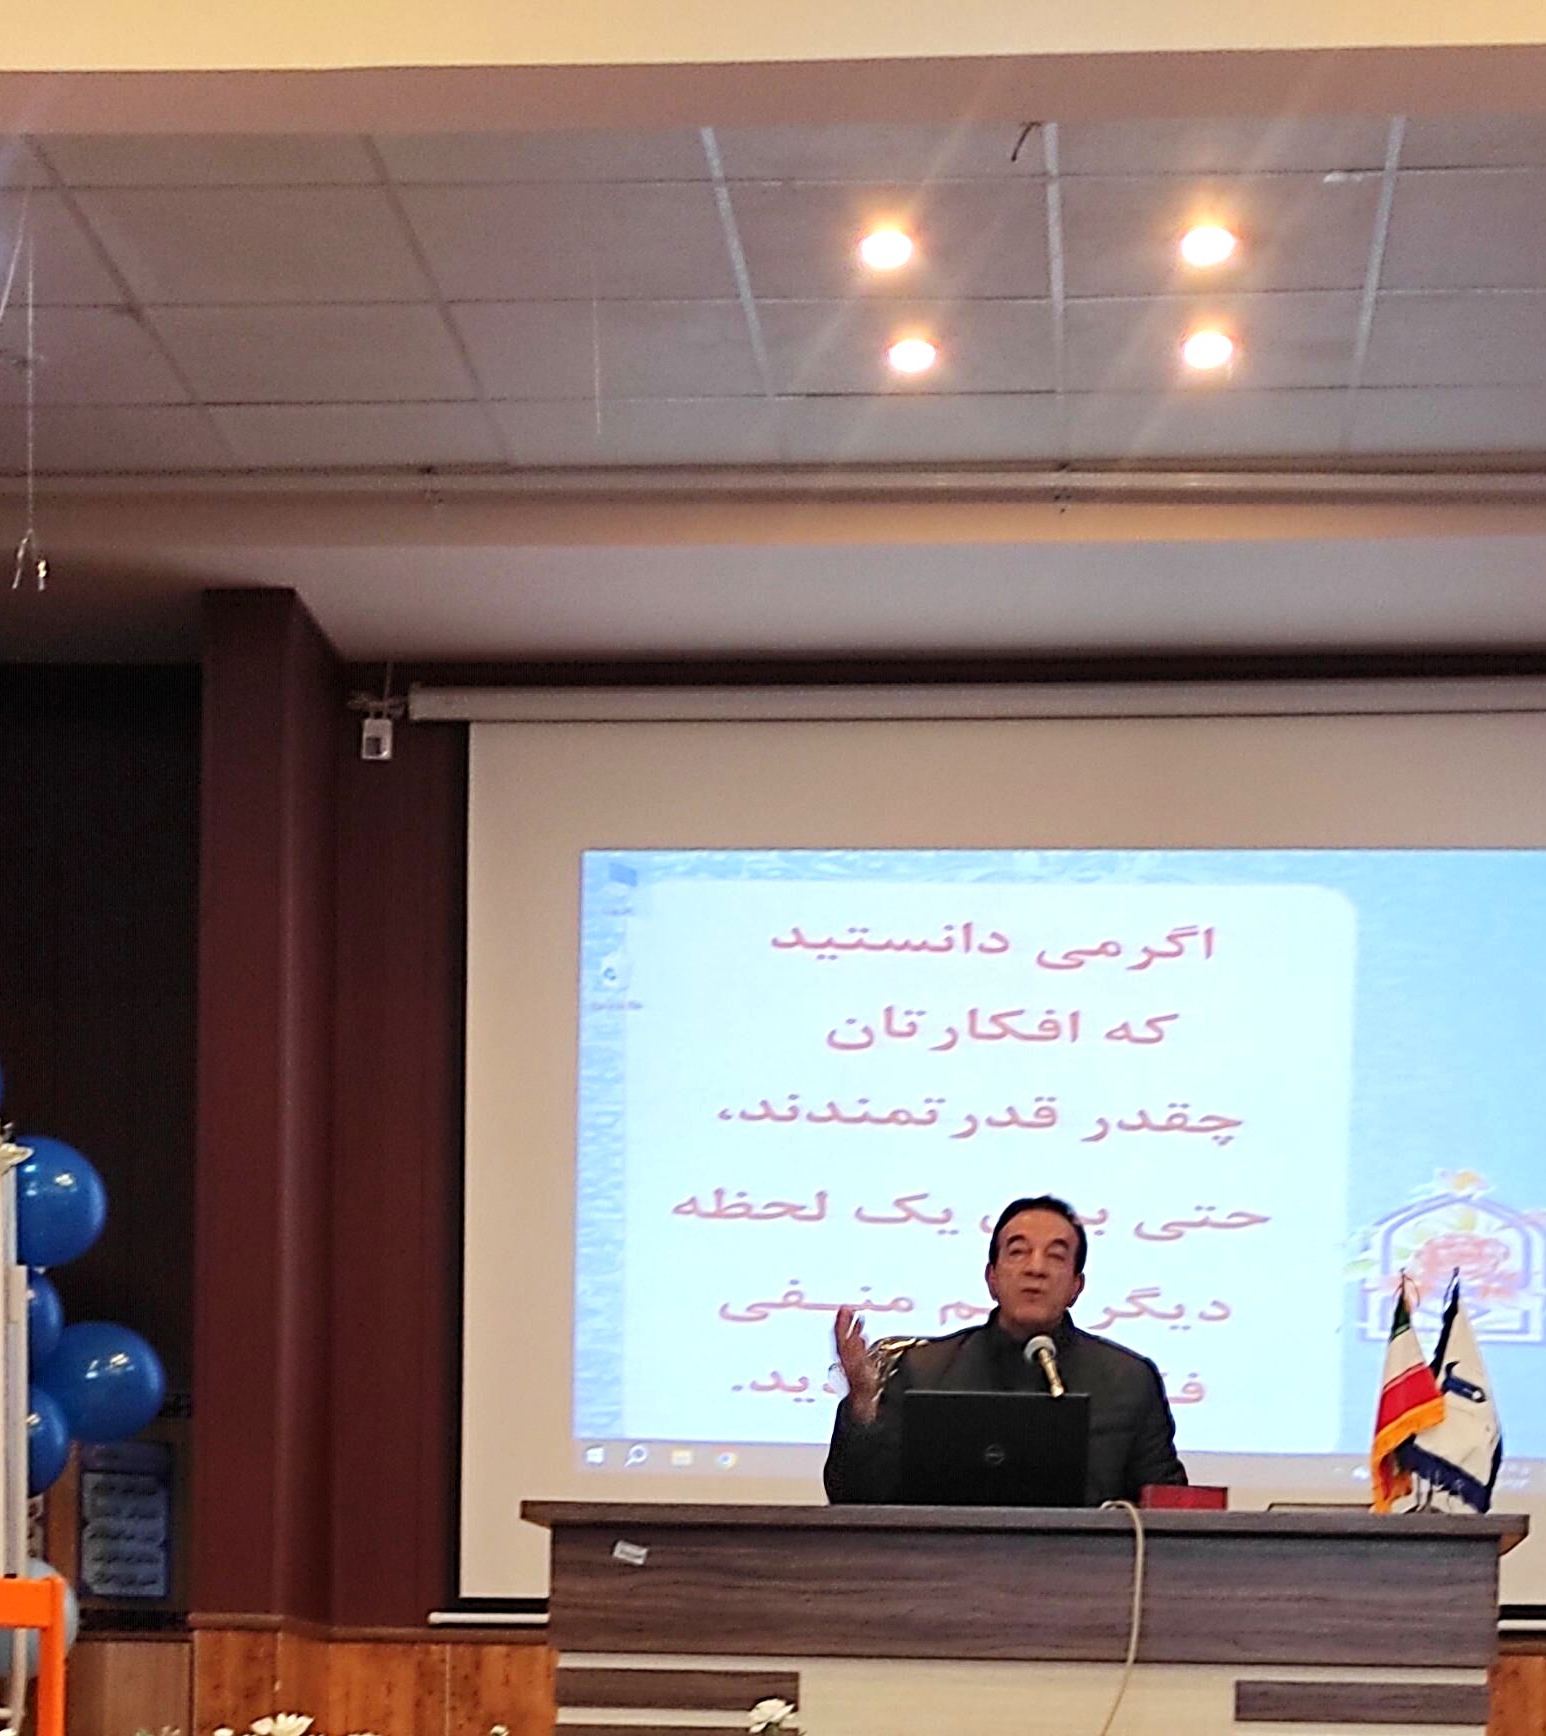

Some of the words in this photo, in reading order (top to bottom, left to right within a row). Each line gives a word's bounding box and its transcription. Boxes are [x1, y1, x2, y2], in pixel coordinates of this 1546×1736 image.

[769, 921, 1011, 961] دانستید
[1103, 1012, 1181, 1045] که
[1080, 1102, 1244, 1147] چقدر
[671, 1186, 829, 1223] لحظه
[853, 1192, 960, 1236] یک
[1133, 1204, 1272, 1242] حتی
[1086, 1286, 1232, 1331] دیگر
